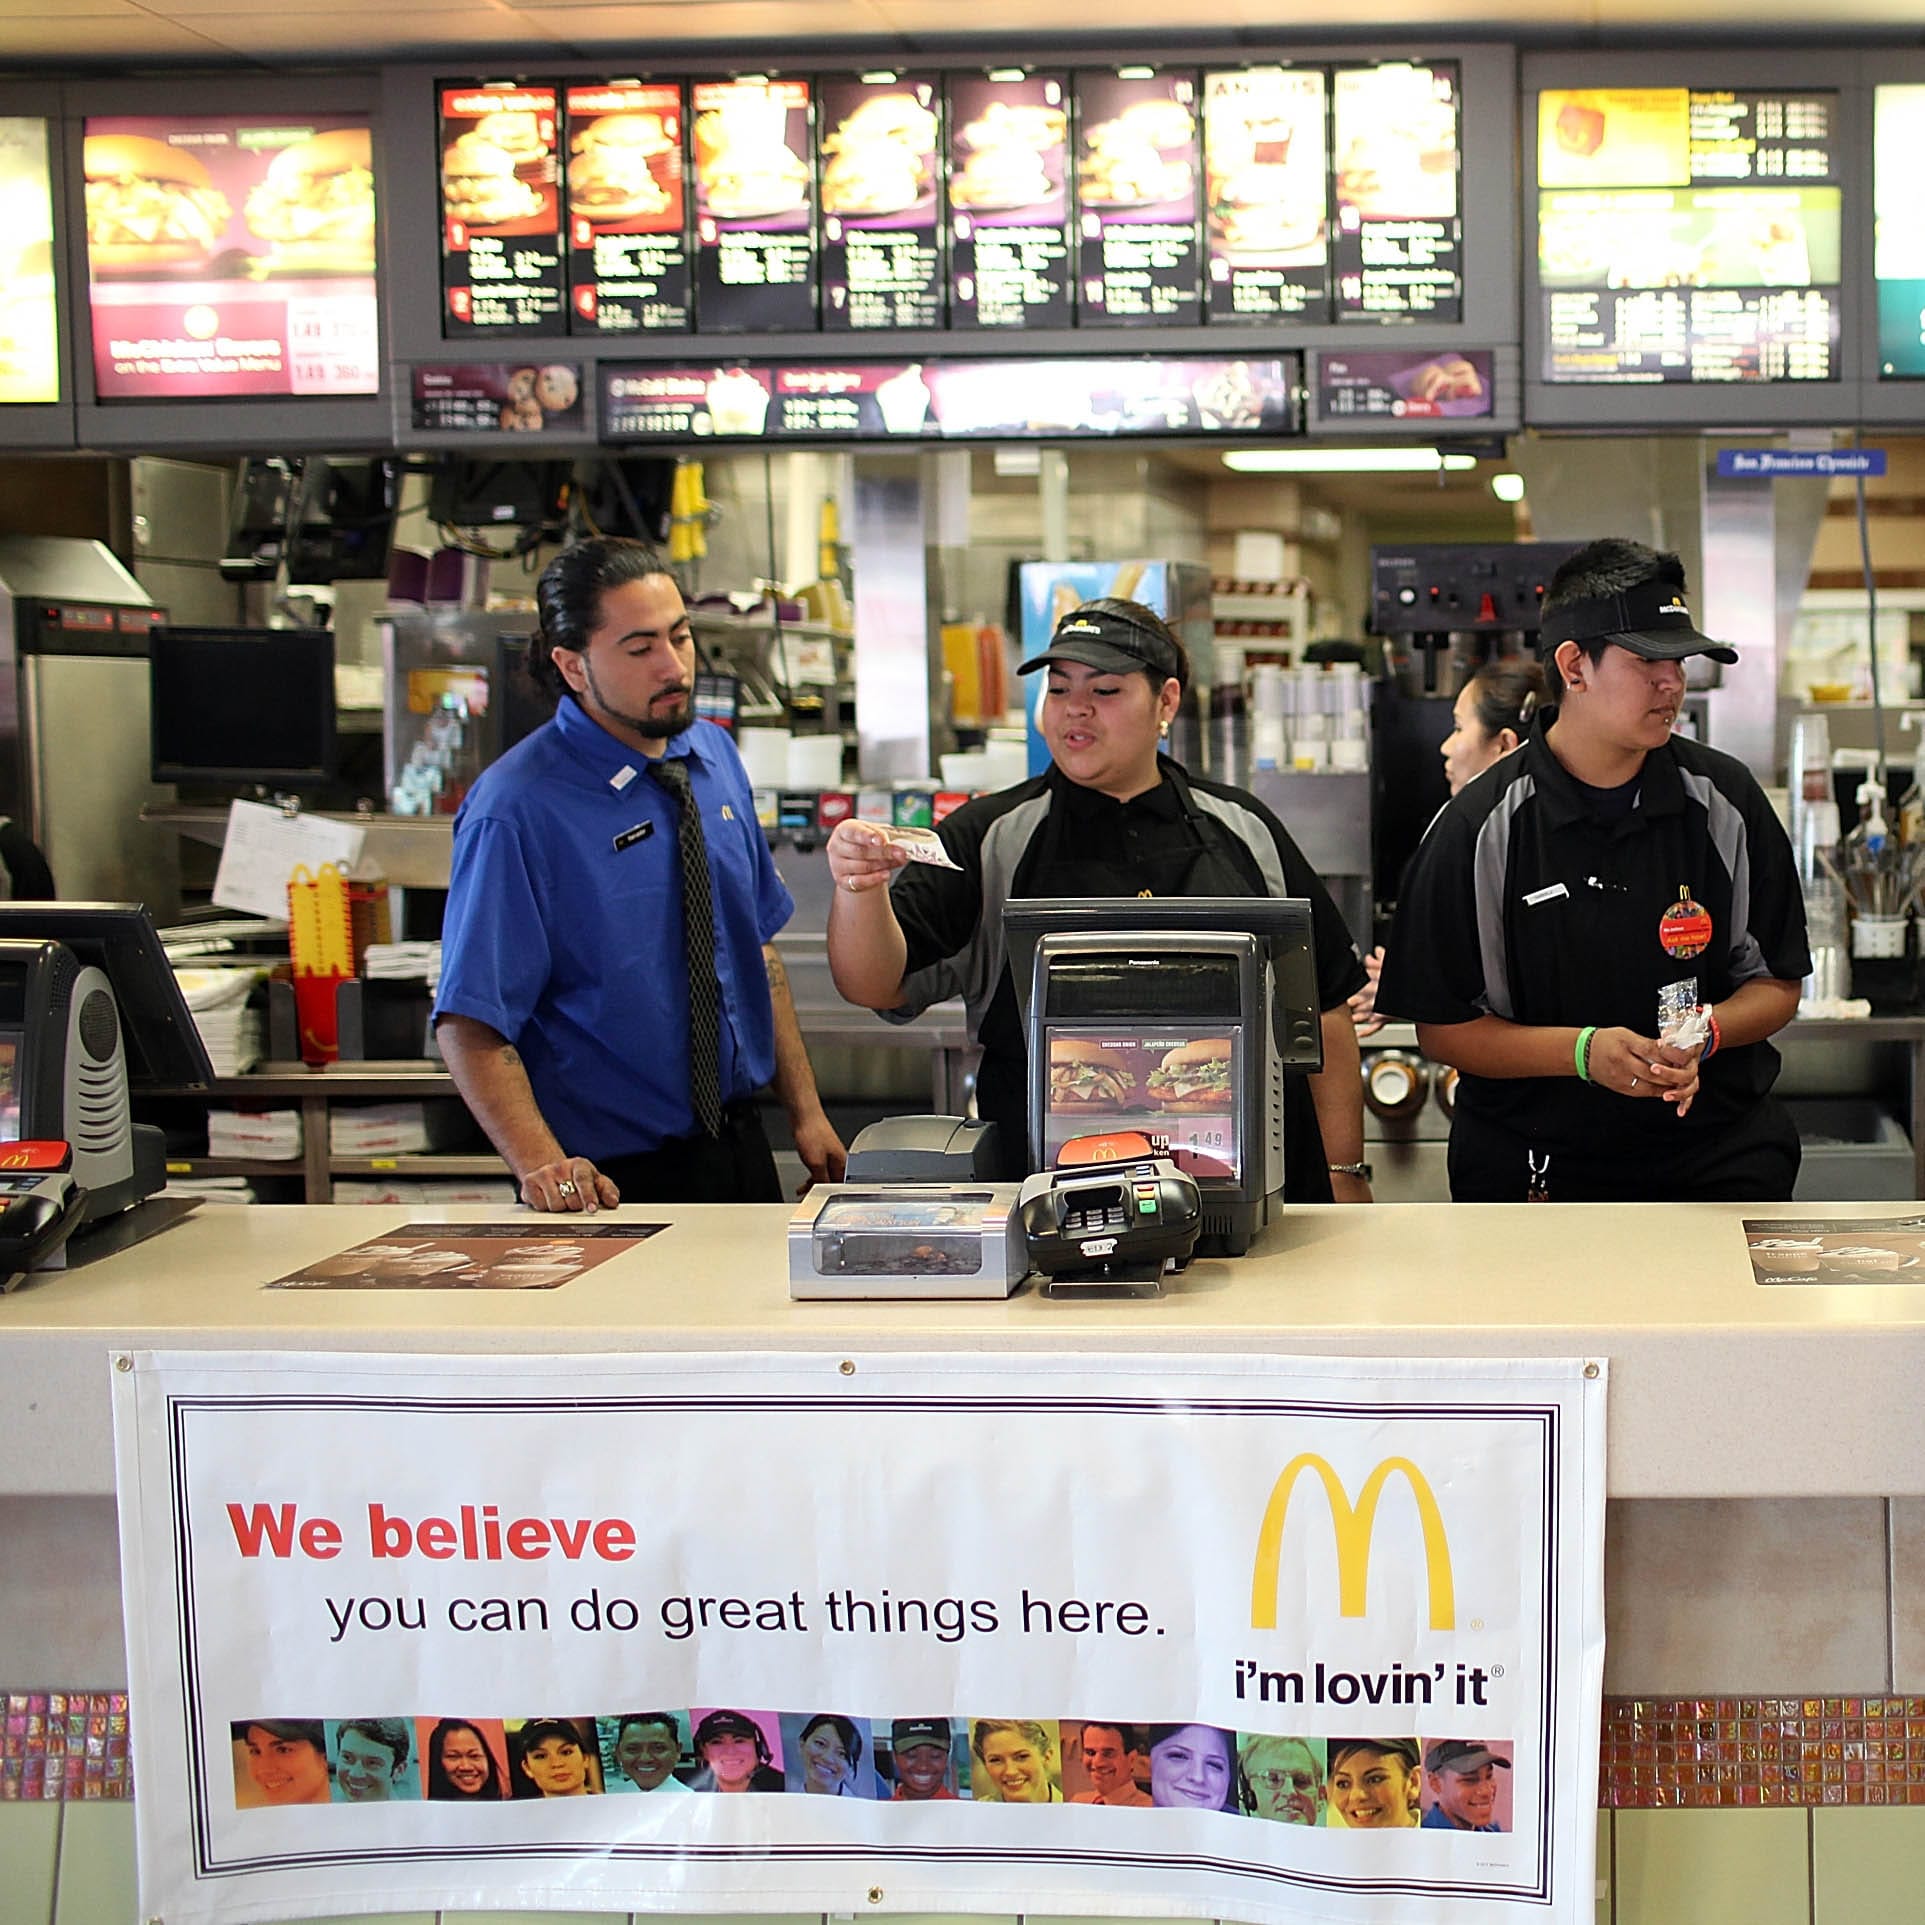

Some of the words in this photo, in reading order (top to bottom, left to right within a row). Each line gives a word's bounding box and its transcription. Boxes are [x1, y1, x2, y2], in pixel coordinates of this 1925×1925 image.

[227, 1503, 342, 1559] We
[368, 1503, 636, 1561] believe
[325, 1597, 426, 1642] you
[448, 1598, 548, 1632] can
[570, 1588, 639, 1632] do
[661, 1591, 808, 1640] great
[824, 1589, 999, 1643] things
[1022, 1589, 1166, 1635] here.
[1235, 1659, 1304, 1703] i'm
[1315, 1663, 1445, 1705] lovin'
